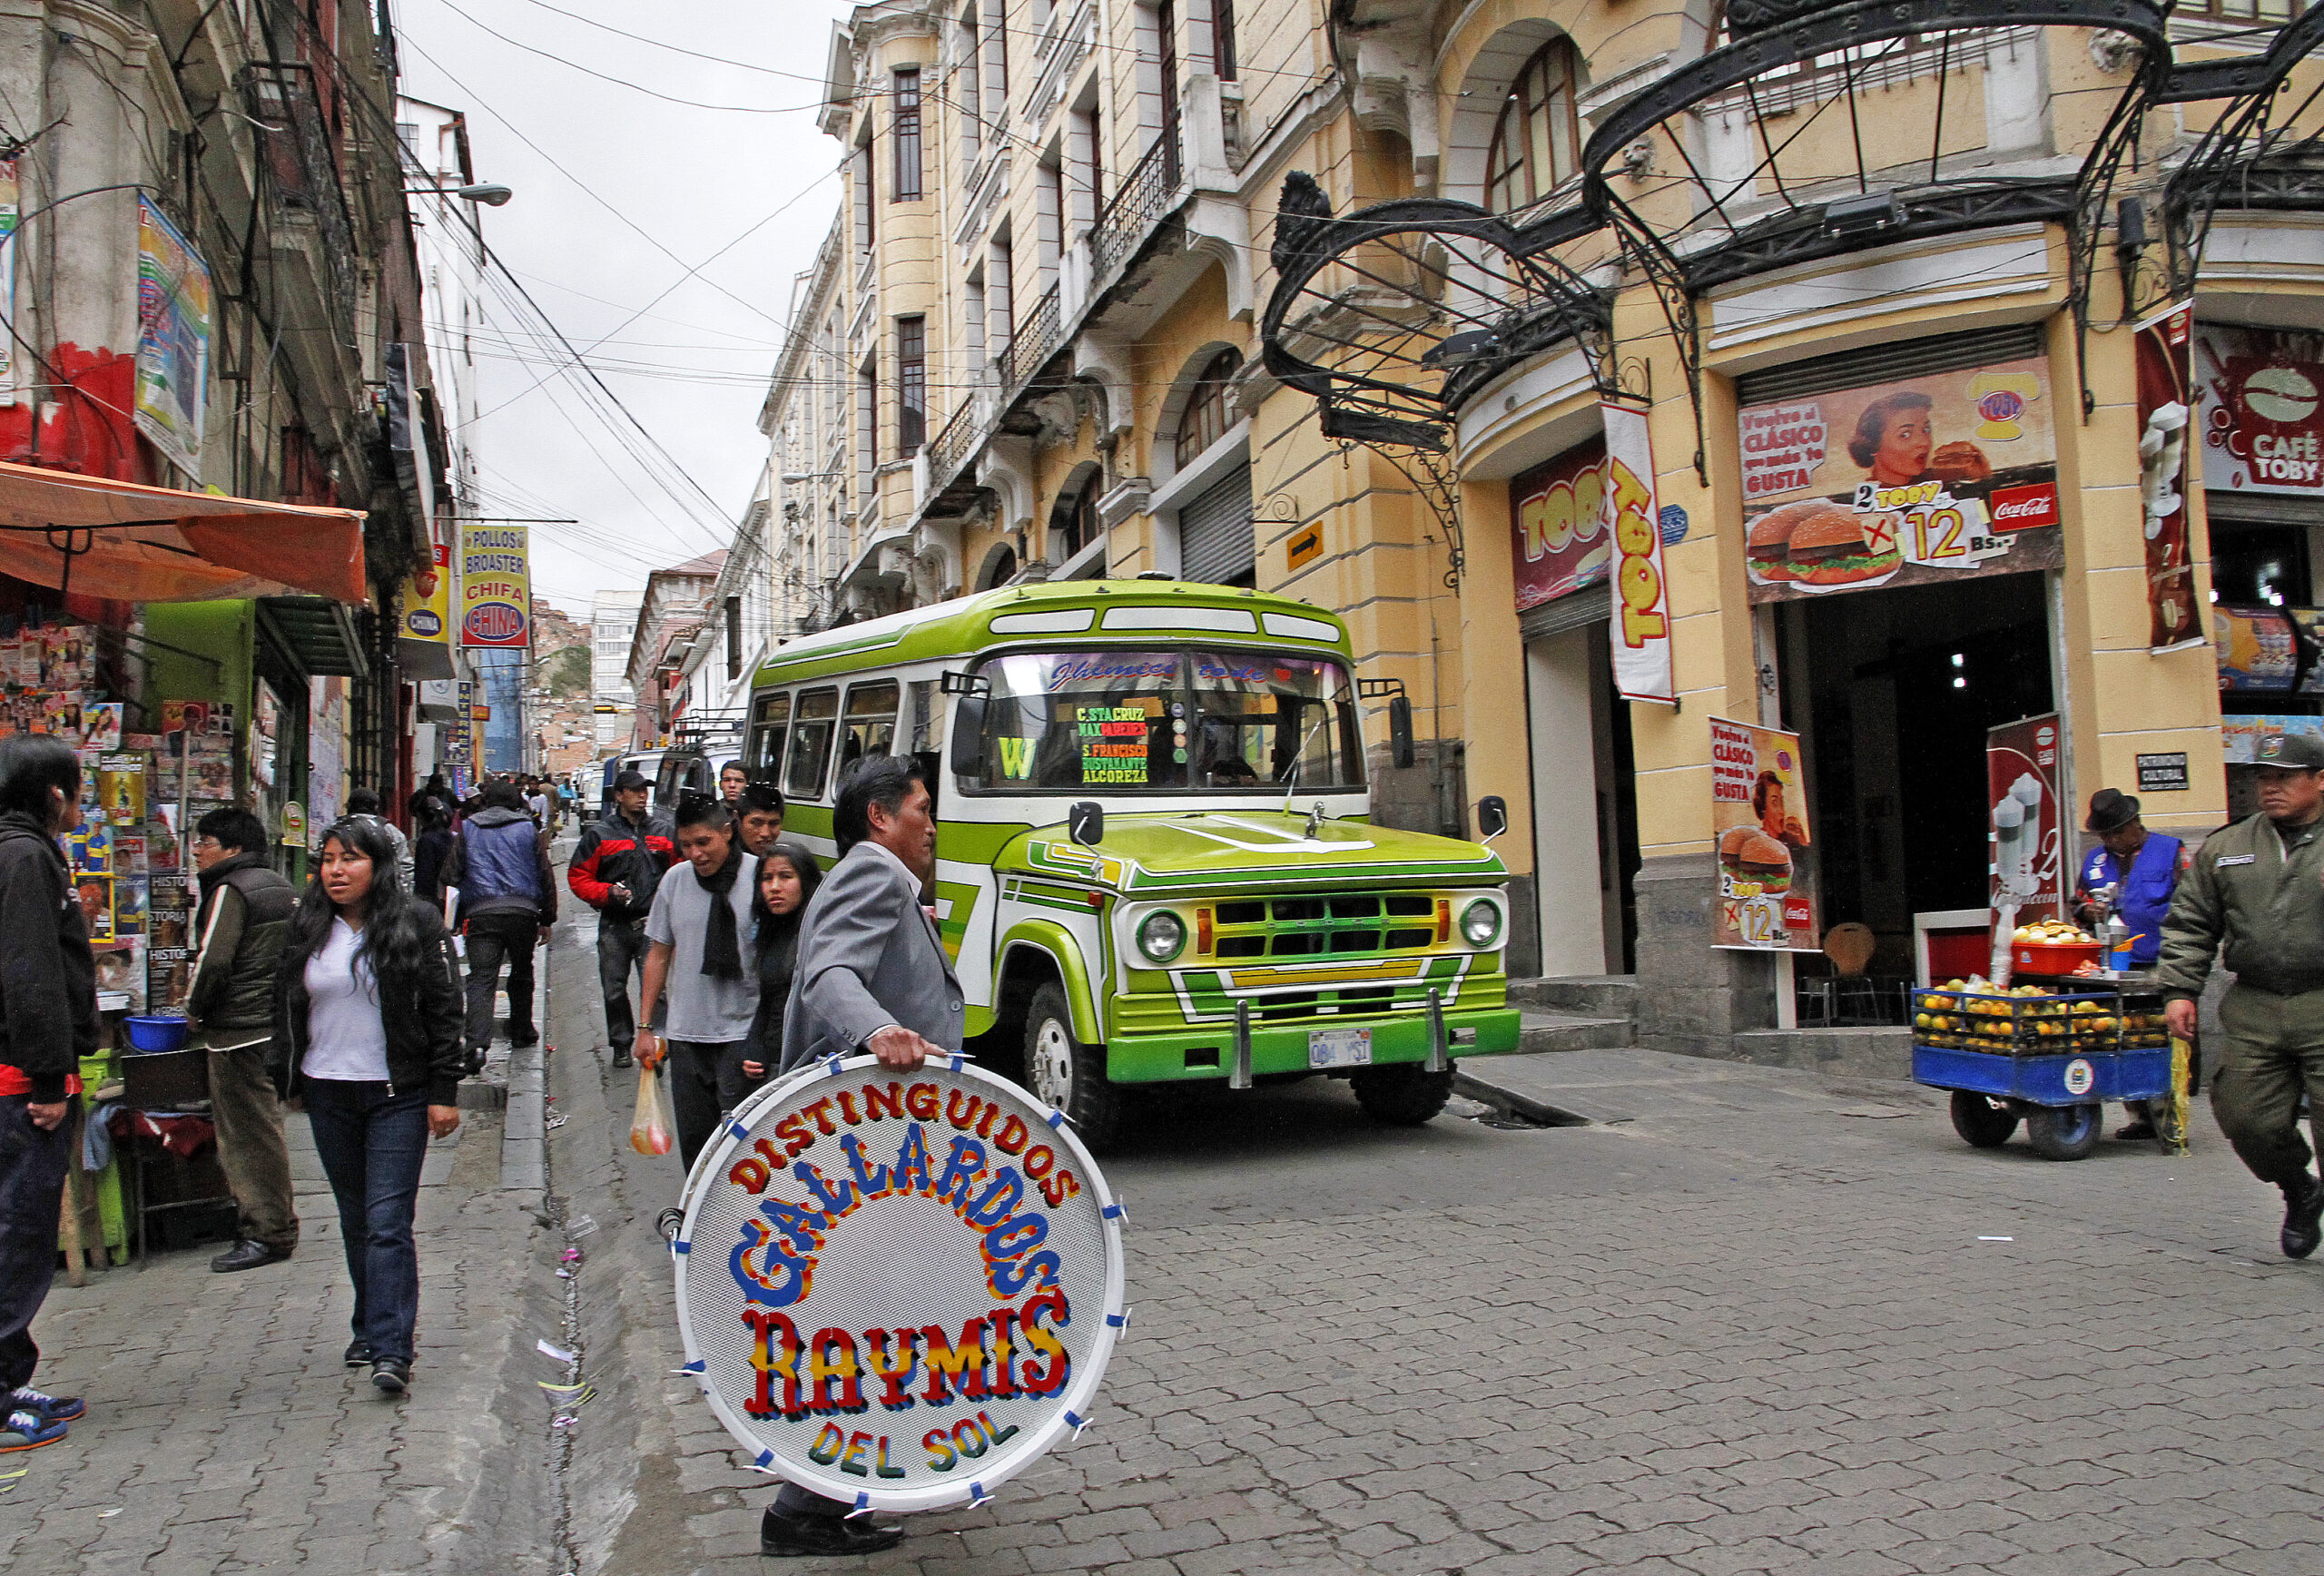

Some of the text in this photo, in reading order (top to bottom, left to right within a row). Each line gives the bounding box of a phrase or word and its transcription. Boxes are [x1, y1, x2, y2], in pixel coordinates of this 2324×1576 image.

[1745, 426, 1823, 453] CLÁSICO
[2253, 431, 2319, 460] CAFÉ
[1748, 468, 1809, 493] GUSTA
[2255, 458, 2319, 482] TOBY
[1519, 456, 1608, 563] TOB
[1861, 486, 1872, 507] 2
[1876, 483, 1940, 507] TOBY
[474, 530, 516, 549] POLLOS
[1906, 508, 1965, 561] 12
[466, 555, 524, 575] BROASTER
[1610, 456, 1667, 649] TOBY
[467, 582, 524, 603] CHIFA
[468, 606, 520, 636] CHINA
[458, 684, 469, 754] INTERNET
[999, 737, 1037, 780] W
[1082, 769, 1148, 783] ALCOREZA
[1715, 782, 1749, 801] GUSTA
[1745, 904, 1770, 941] 12
[729, 1080, 1080, 1208] DISTINGUIDOS
[728, 1122, 1062, 1308] GALLARDOS
[741, 1284, 1071, 1423] RAYMIS
[809, 1410, 1019, 1480] DEL SOL
